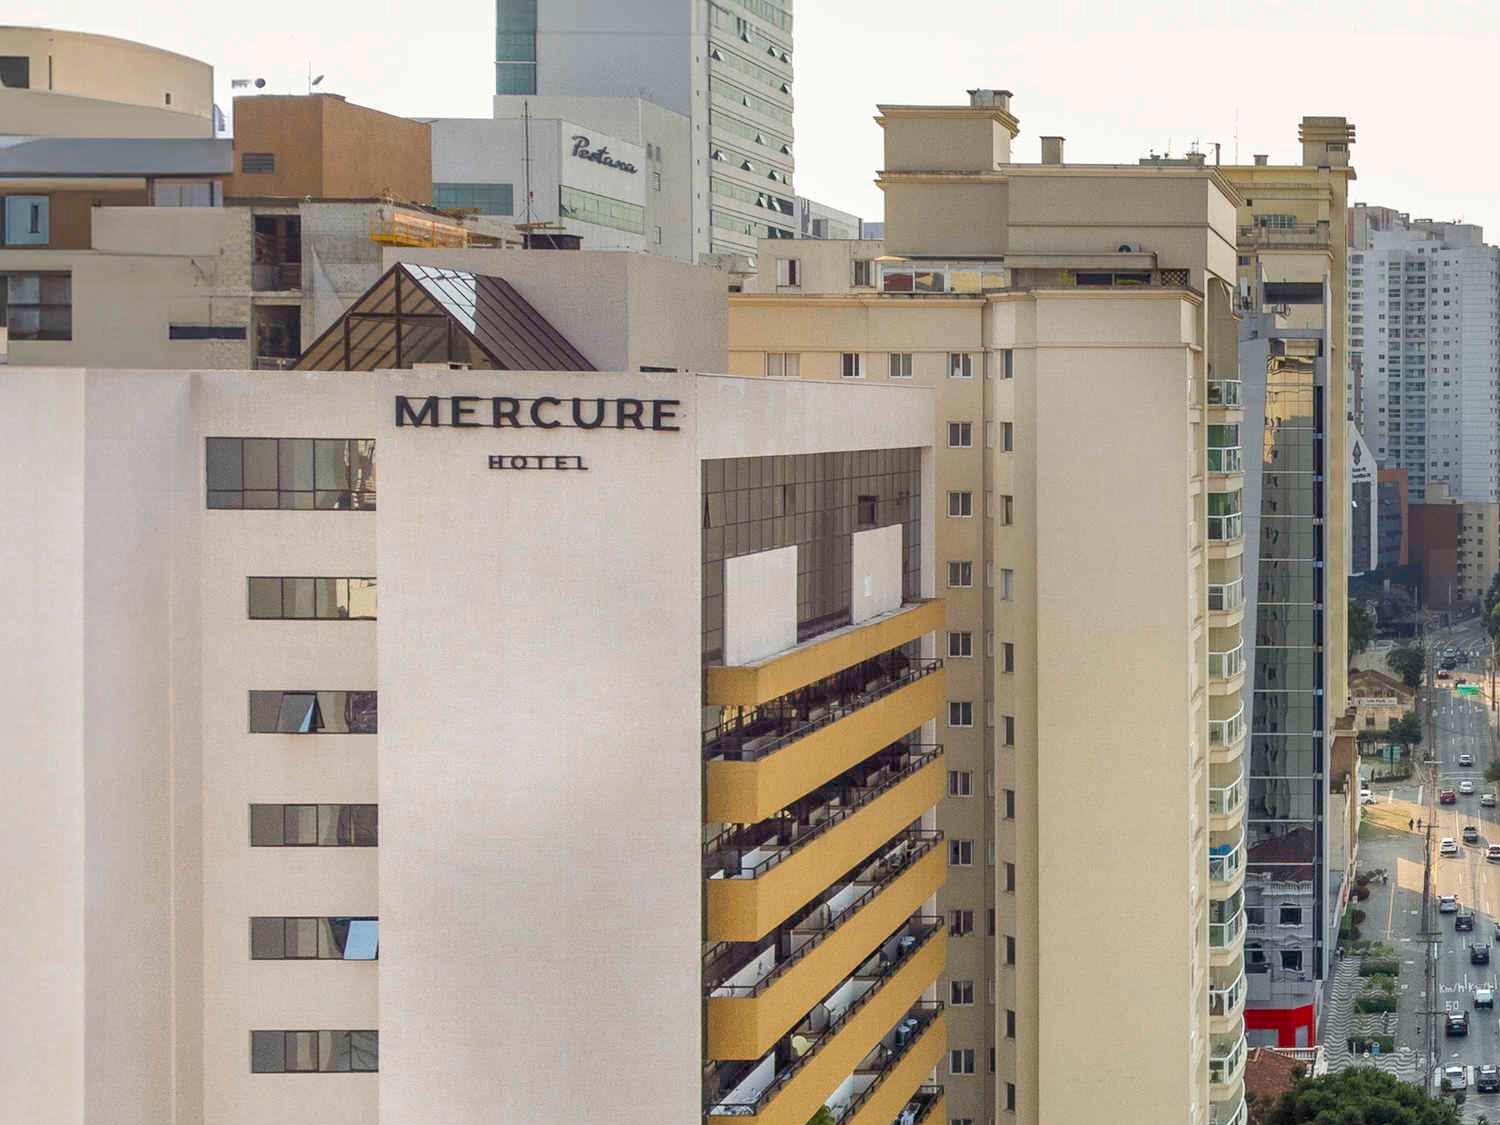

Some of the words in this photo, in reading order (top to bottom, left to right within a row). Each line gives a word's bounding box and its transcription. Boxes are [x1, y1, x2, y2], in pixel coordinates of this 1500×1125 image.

[571, 135, 638, 174] Pestana
[395, 395, 680, 431] MERCURE
[488, 455, 588, 471] HOTEL
[1445, 1000, 1459, 1011] 50
